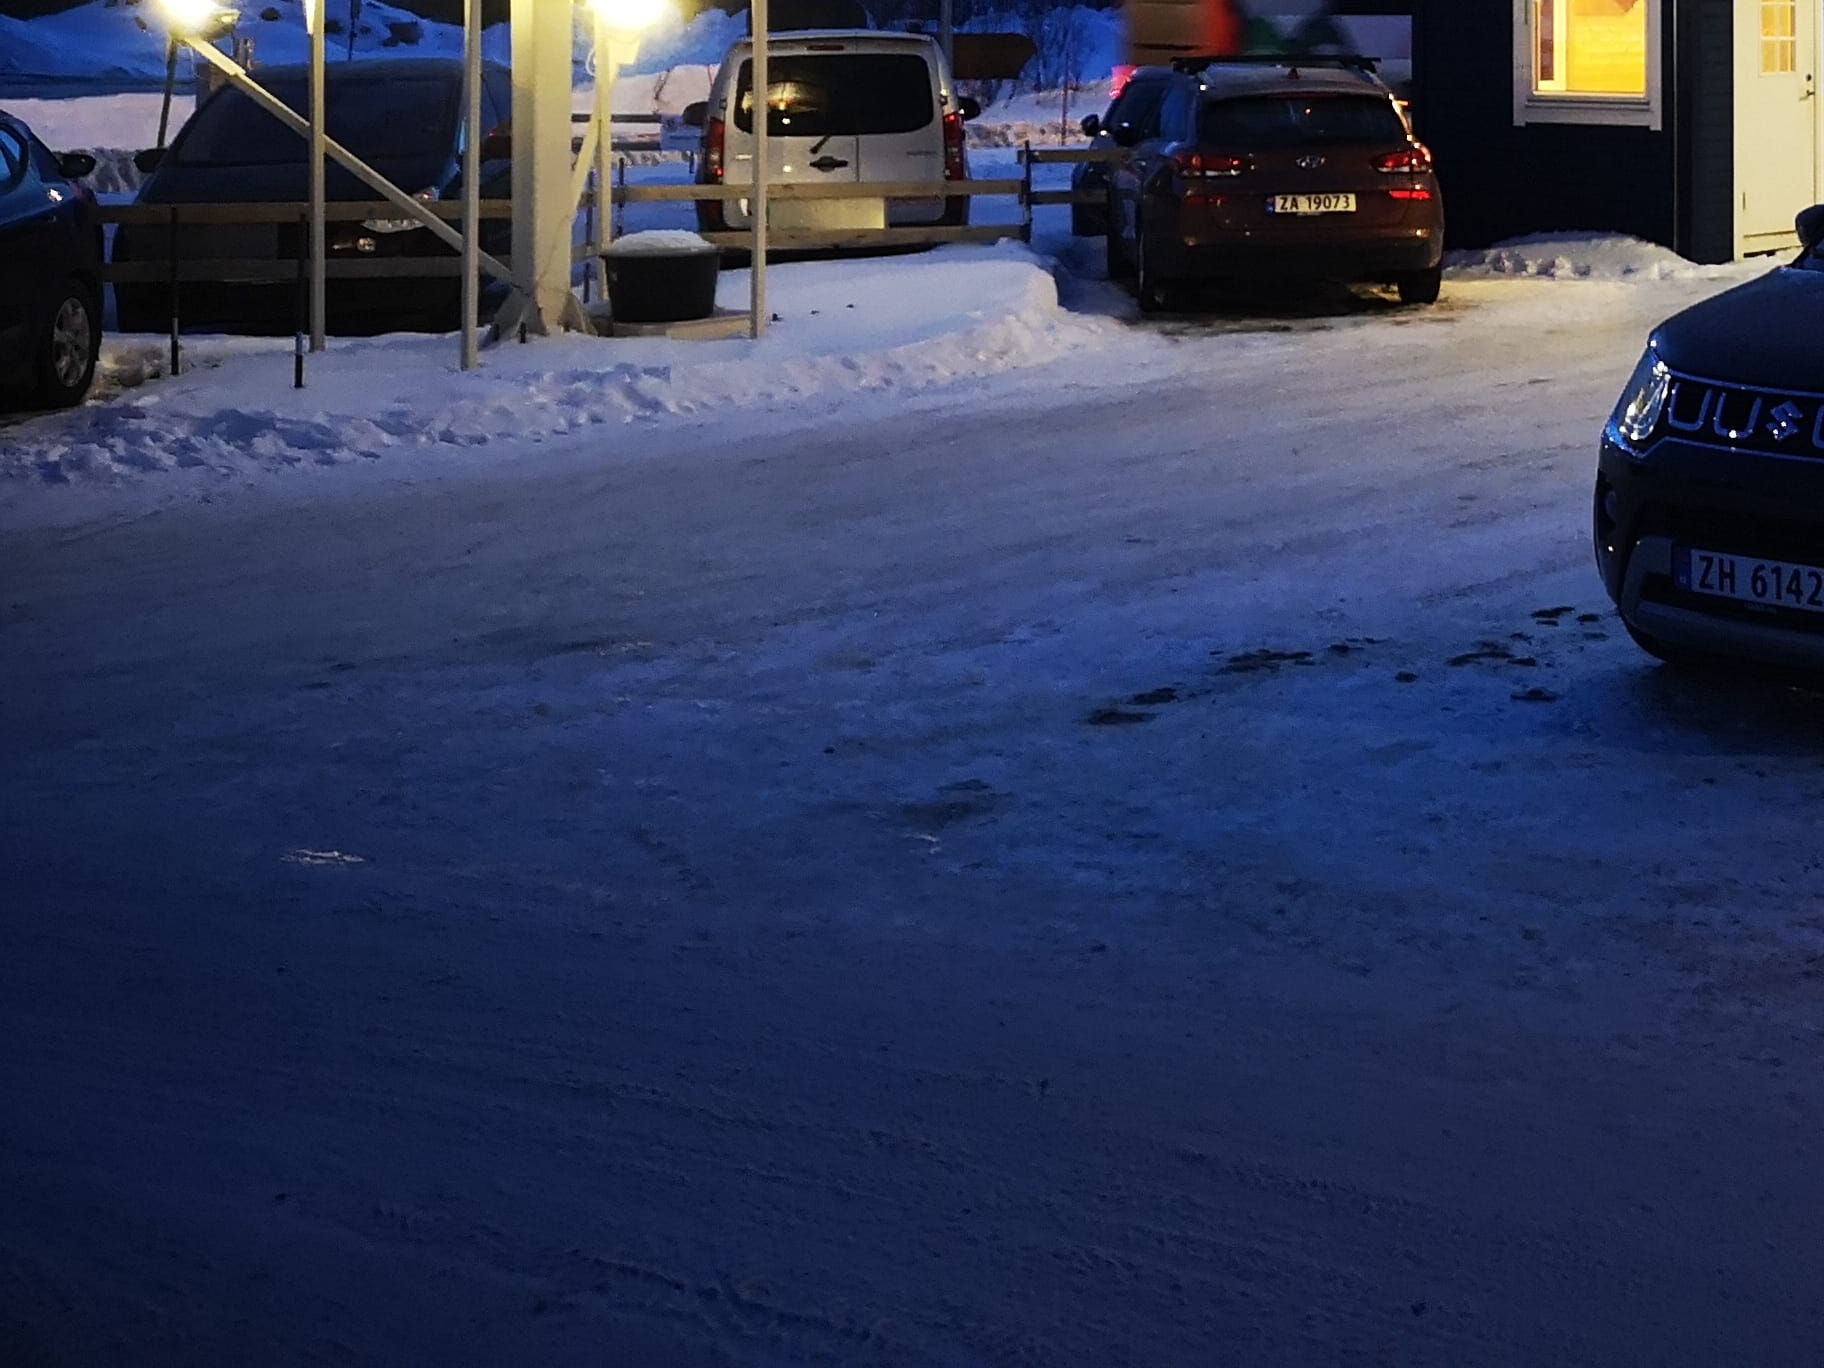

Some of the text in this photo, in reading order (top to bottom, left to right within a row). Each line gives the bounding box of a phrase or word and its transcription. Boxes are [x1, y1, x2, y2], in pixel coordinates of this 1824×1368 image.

[1280, 194, 1350, 210] ZA 19073
[1699, 555, 1736, 594] ZH
